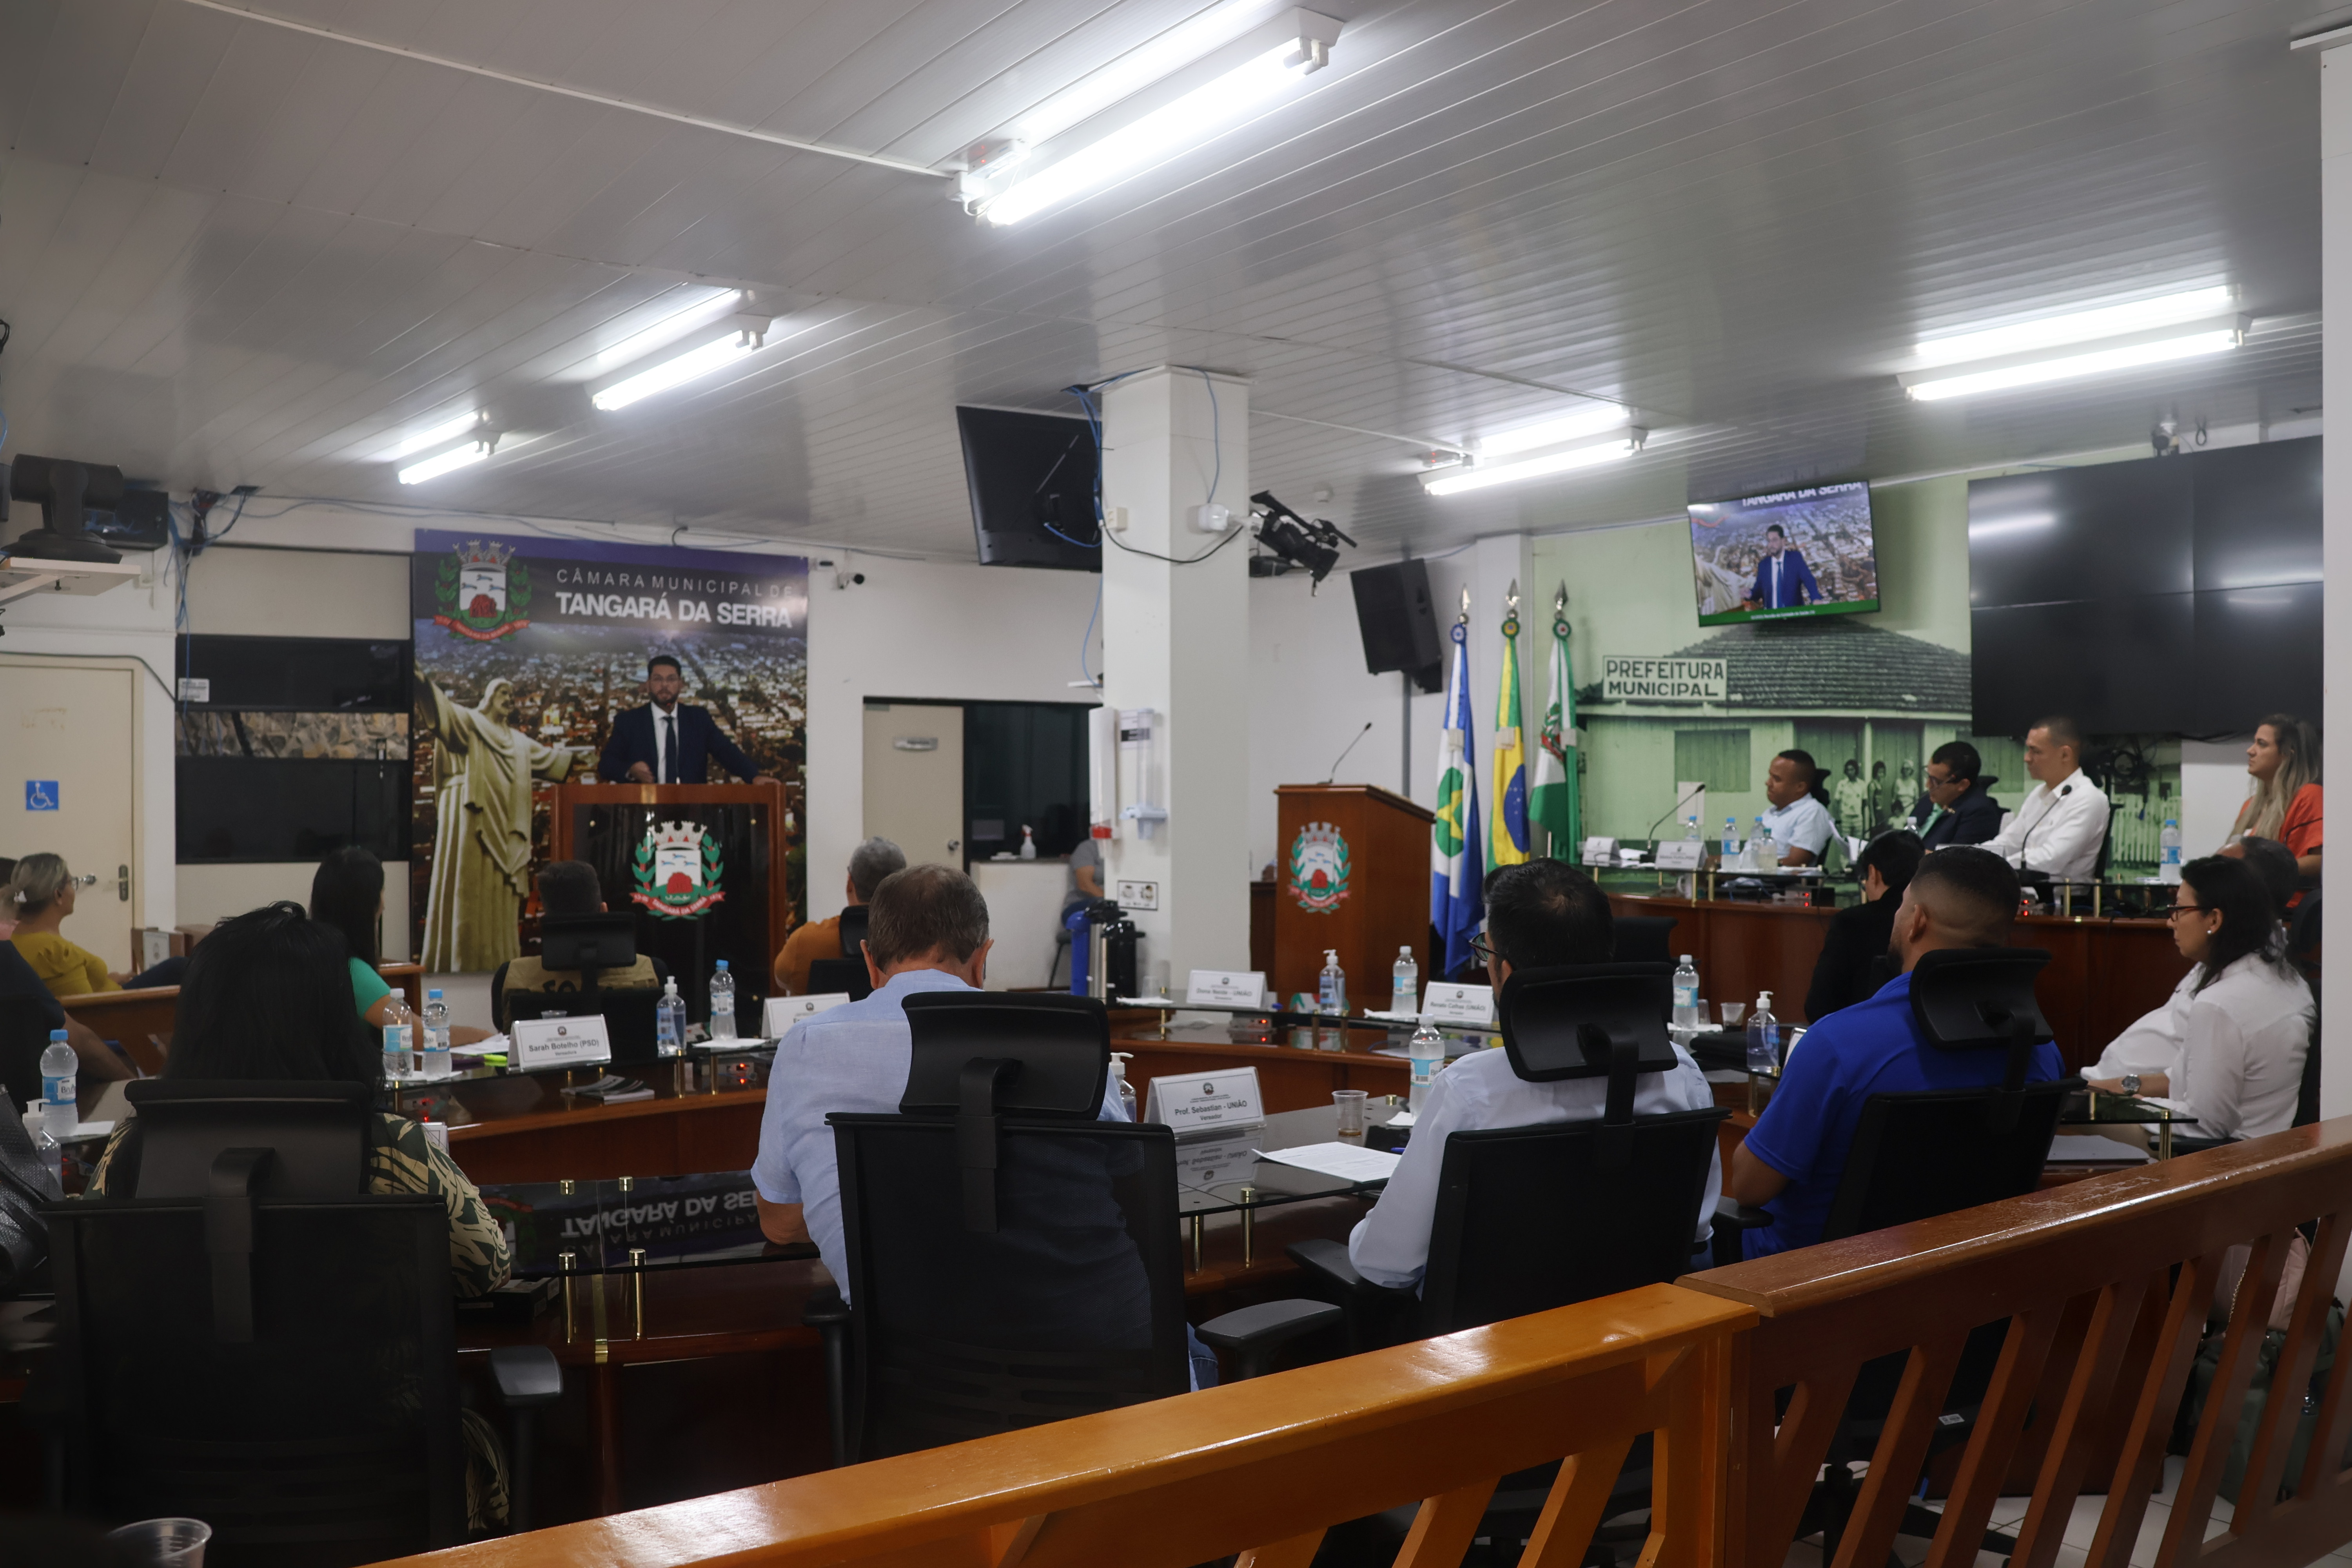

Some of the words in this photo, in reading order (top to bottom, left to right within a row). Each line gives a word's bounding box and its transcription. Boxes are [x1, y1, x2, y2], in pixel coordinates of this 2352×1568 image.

[557, 568, 645, 588] CÂMARA
[652, 575, 762, 597] MUNICIPAL
[770, 584, 792, 598] DE
[555, 592, 672, 620] TANGARÁ
[679, 599, 711, 623] DA
[717, 602, 793, 628] SERRA
[1607, 660, 1724, 680] PREFEITURA
[1609, 681, 1719, 697] MUNICIPAL
[529, 1043, 550, 1052] Sarah
[551, 1041, 578, 1050] Botelho
[580, 1039, 599, 1048] (PSD)
[1175, 1107, 1190, 1116] Prof.
[1191, 1104, 1222, 1114] Sebastian
[1227, 1099, 1247, 1109] UNIÃO
